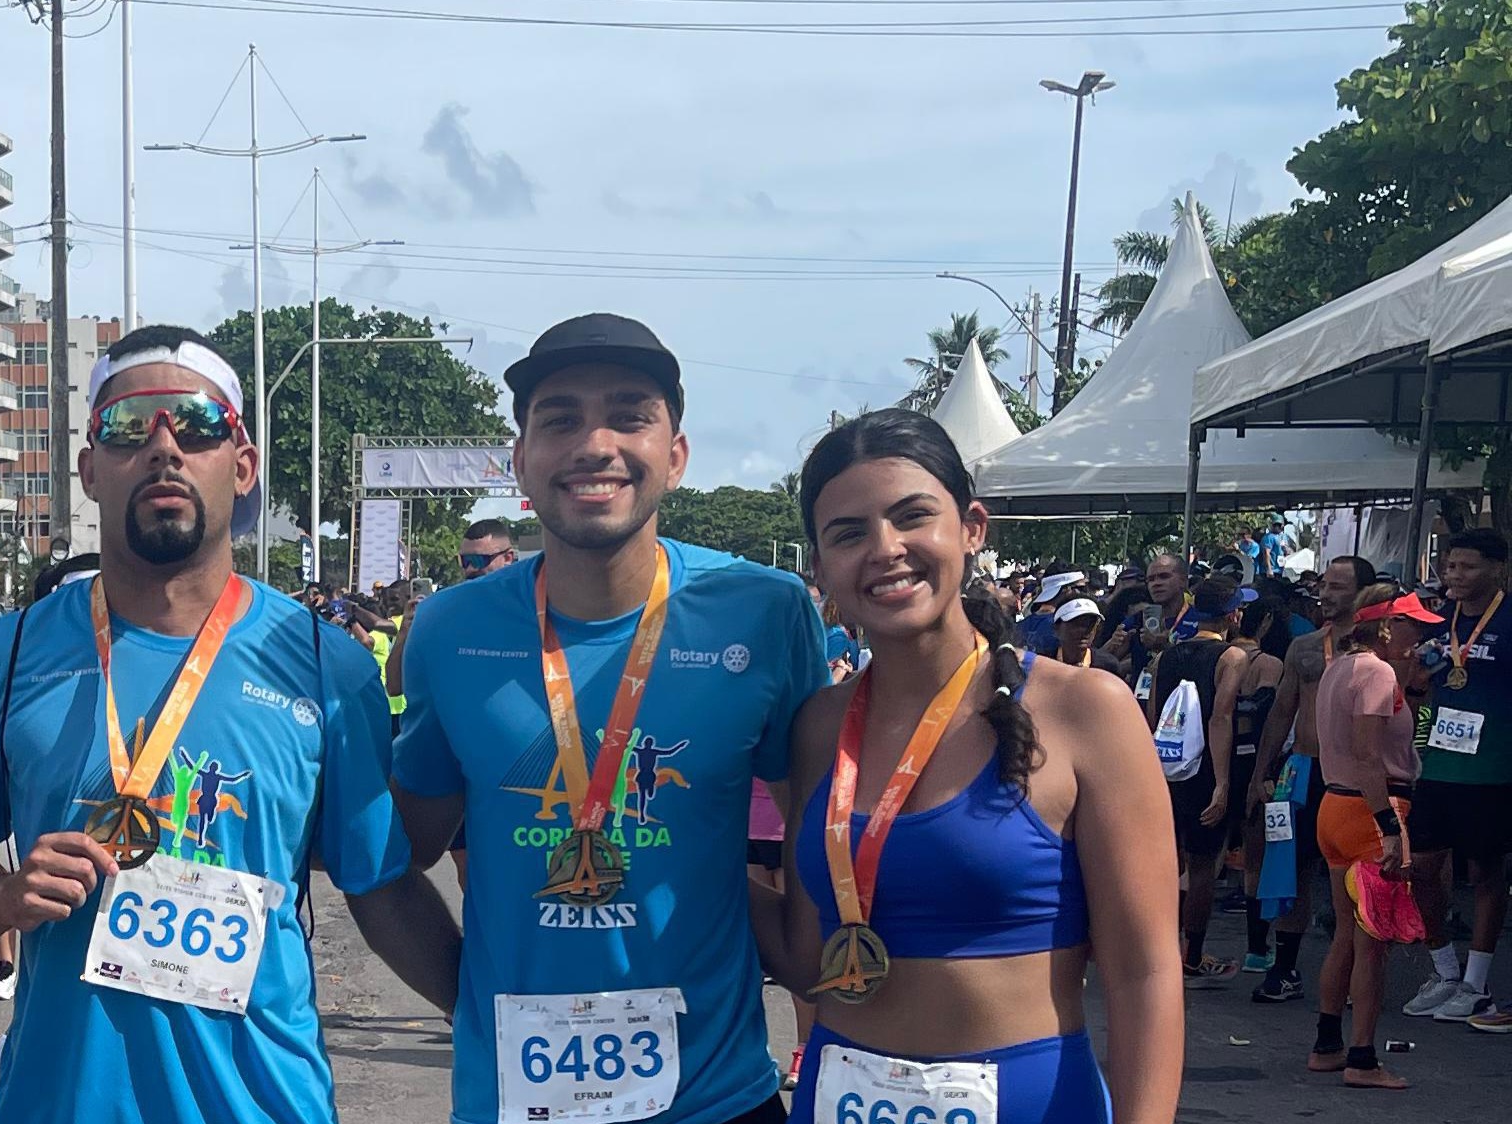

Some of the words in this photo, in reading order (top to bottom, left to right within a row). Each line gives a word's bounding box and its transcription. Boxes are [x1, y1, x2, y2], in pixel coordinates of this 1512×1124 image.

[670, 648, 720, 665] Rotary
[242, 681, 291, 709] Rotary
[1437, 719, 1475, 740] 6651
[1267, 813, 1287, 829] 32
[635, 828, 672, 847] DA
[539, 902, 637, 929] ZEISS
[108, 891, 249, 964] 6363
[150, 959, 190, 975] SIMONE
[521, 1030, 663, 1084] 6483
[574, 1091, 613, 1101] EFRAIM
